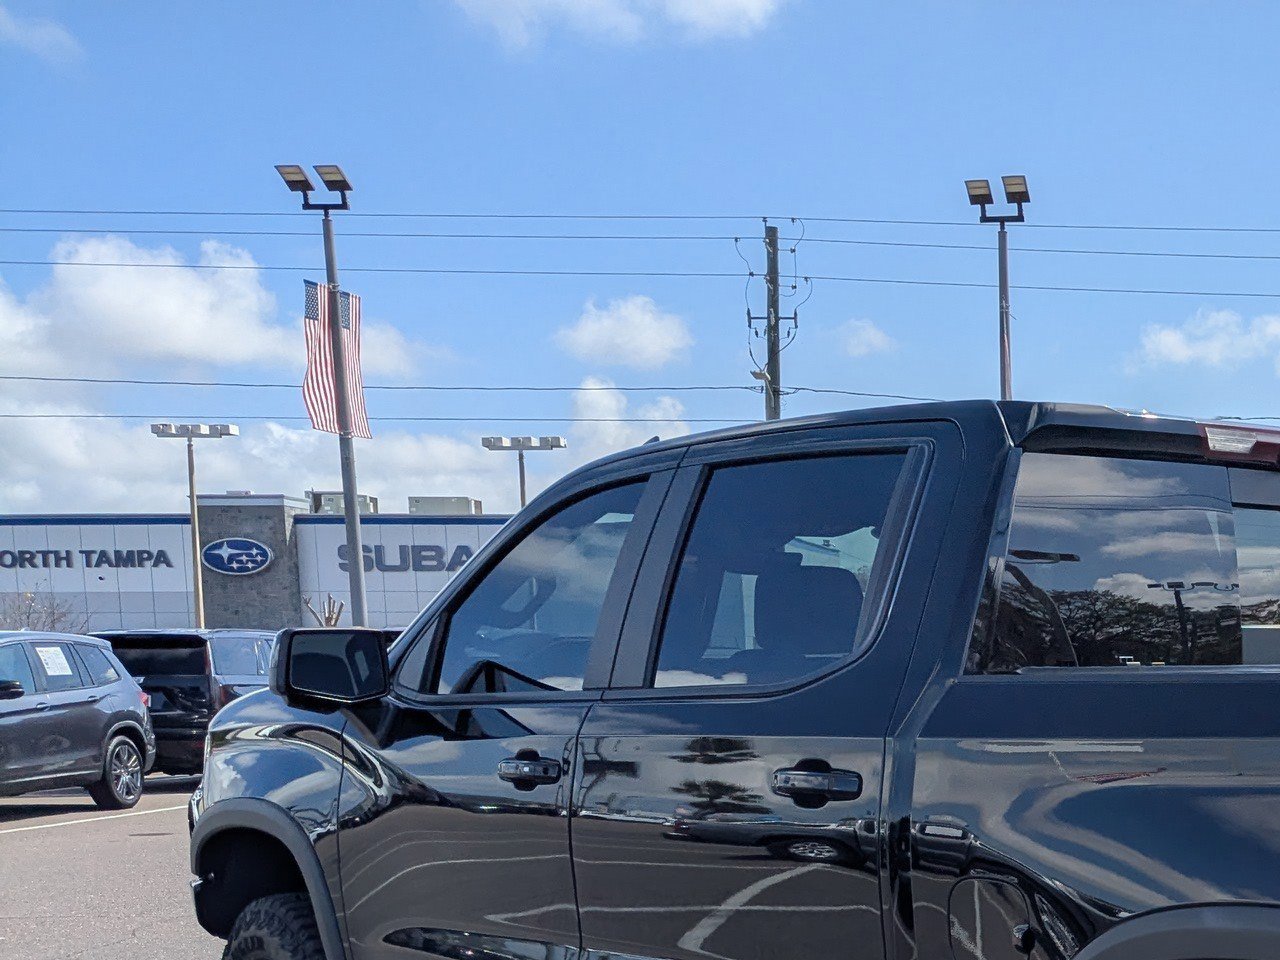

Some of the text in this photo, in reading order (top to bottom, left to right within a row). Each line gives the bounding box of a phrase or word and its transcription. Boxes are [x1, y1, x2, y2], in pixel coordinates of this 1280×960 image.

[0, 550, 174, 568] ORTH TAMPA
[337, 544, 475, 572] SUBA
